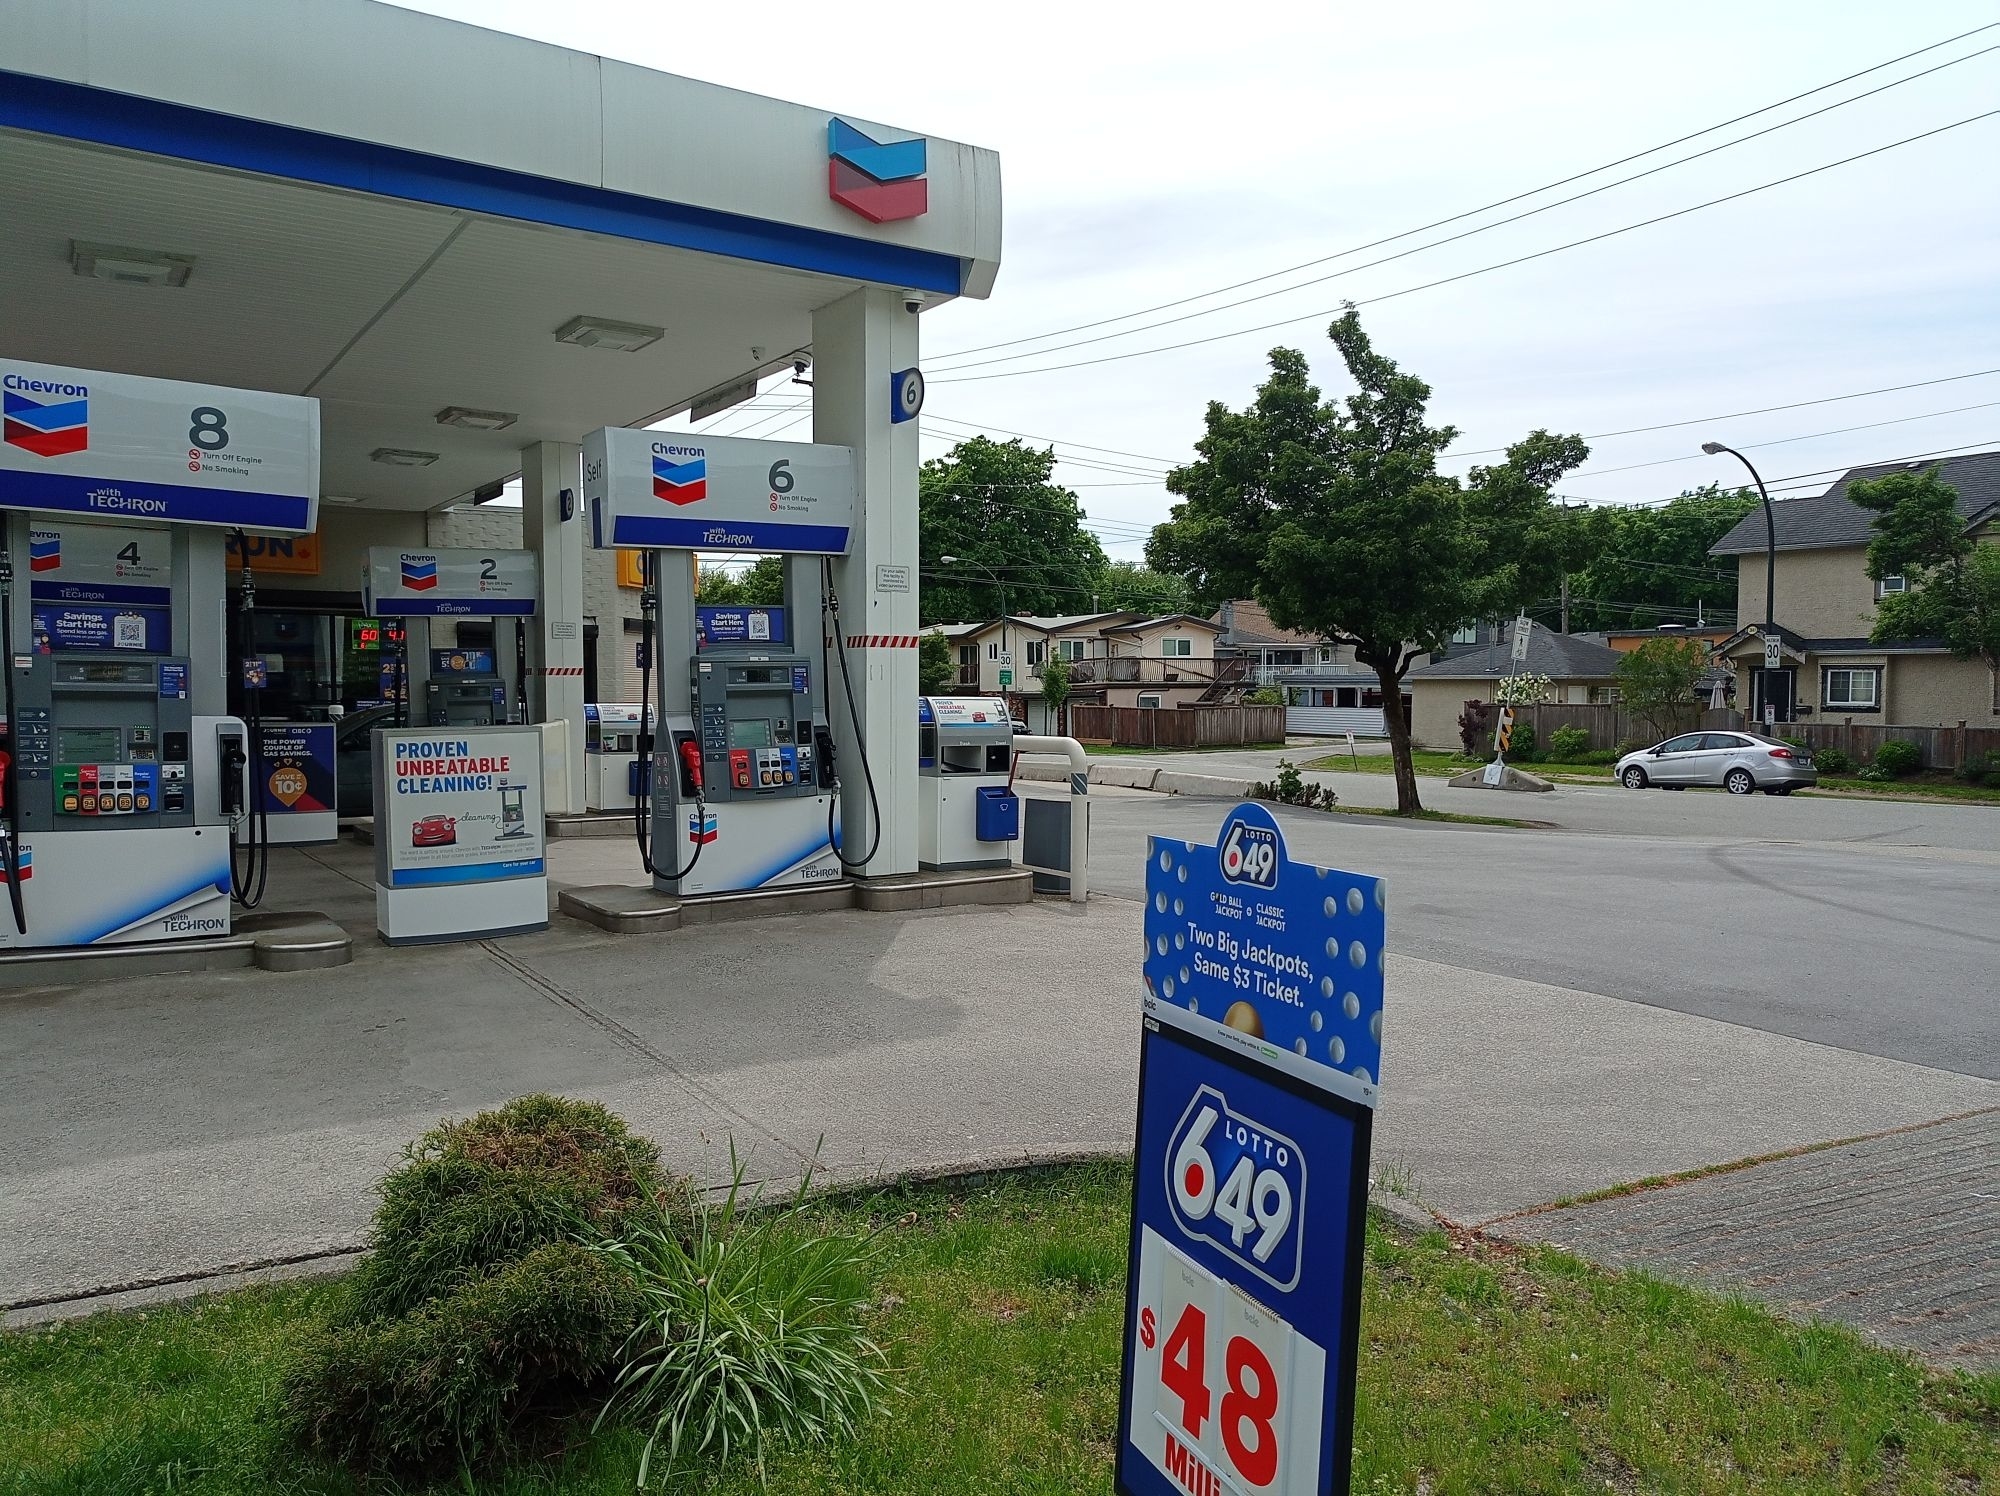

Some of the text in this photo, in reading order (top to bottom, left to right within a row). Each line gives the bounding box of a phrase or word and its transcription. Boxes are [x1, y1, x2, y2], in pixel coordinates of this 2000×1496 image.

[3, 374, 88, 397] Chevron
[907, 381, 916, 404] 6
[189, 407, 229, 450] 8
[651, 442, 705, 457] Chevron
[202, 452, 220, 460] Turn
[236, 455, 262, 464] Engine
[215, 466, 249, 476] Smoking
[587, 459, 602, 482] Self
[769, 459, 794, 493] 6
[97, 487, 121, 497] with
[87, 492, 165, 513] TECHRON
[30, 530, 60, 539] evron
[702, 531, 753, 546] TECHRON
[117, 542, 140, 565] 4
[400, 554, 436, 562] Chevron
[480, 559, 497, 579] 2
[60, 590, 105, 600] TECHRON
[436, 605, 471, 613] TECHRON
[56, 620, 108, 629] Start Here
[63, 612, 103, 622] Savings
[361, 630, 377, 640] 60
[1767, 644, 1778, 658] 30
[1001, 656, 1010, 665] 30
[396, 741, 468, 758] PROVEN
[396, 757, 510, 776] UNBEATABLE
[275, 780, 302, 794] 10¢
[397, 775, 492, 794] CLEANING!
[461, 812, 496, 822] cleaning
[1245, 829, 1272, 842] LOTTO
[1223, 827, 1274, 883] 649
[801, 868, 840, 878] TECHRON
[1228, 896, 1242, 908] BALL
[1215, 904, 1242, 920] JACKPOT
[1256, 903, 1284, 918] CLASSIC
[163, 918, 225, 932] TECHRON
[1256, 915, 1286, 932] JACKPOT
[1187, 922, 1314, 984] Two Big Jackpots,
[1194, 952, 1304, 1007] Same $3 Ticket.
[1225, 1120, 1289, 1168] LOTTO
[1173, 1105, 1292, 1264] 649
